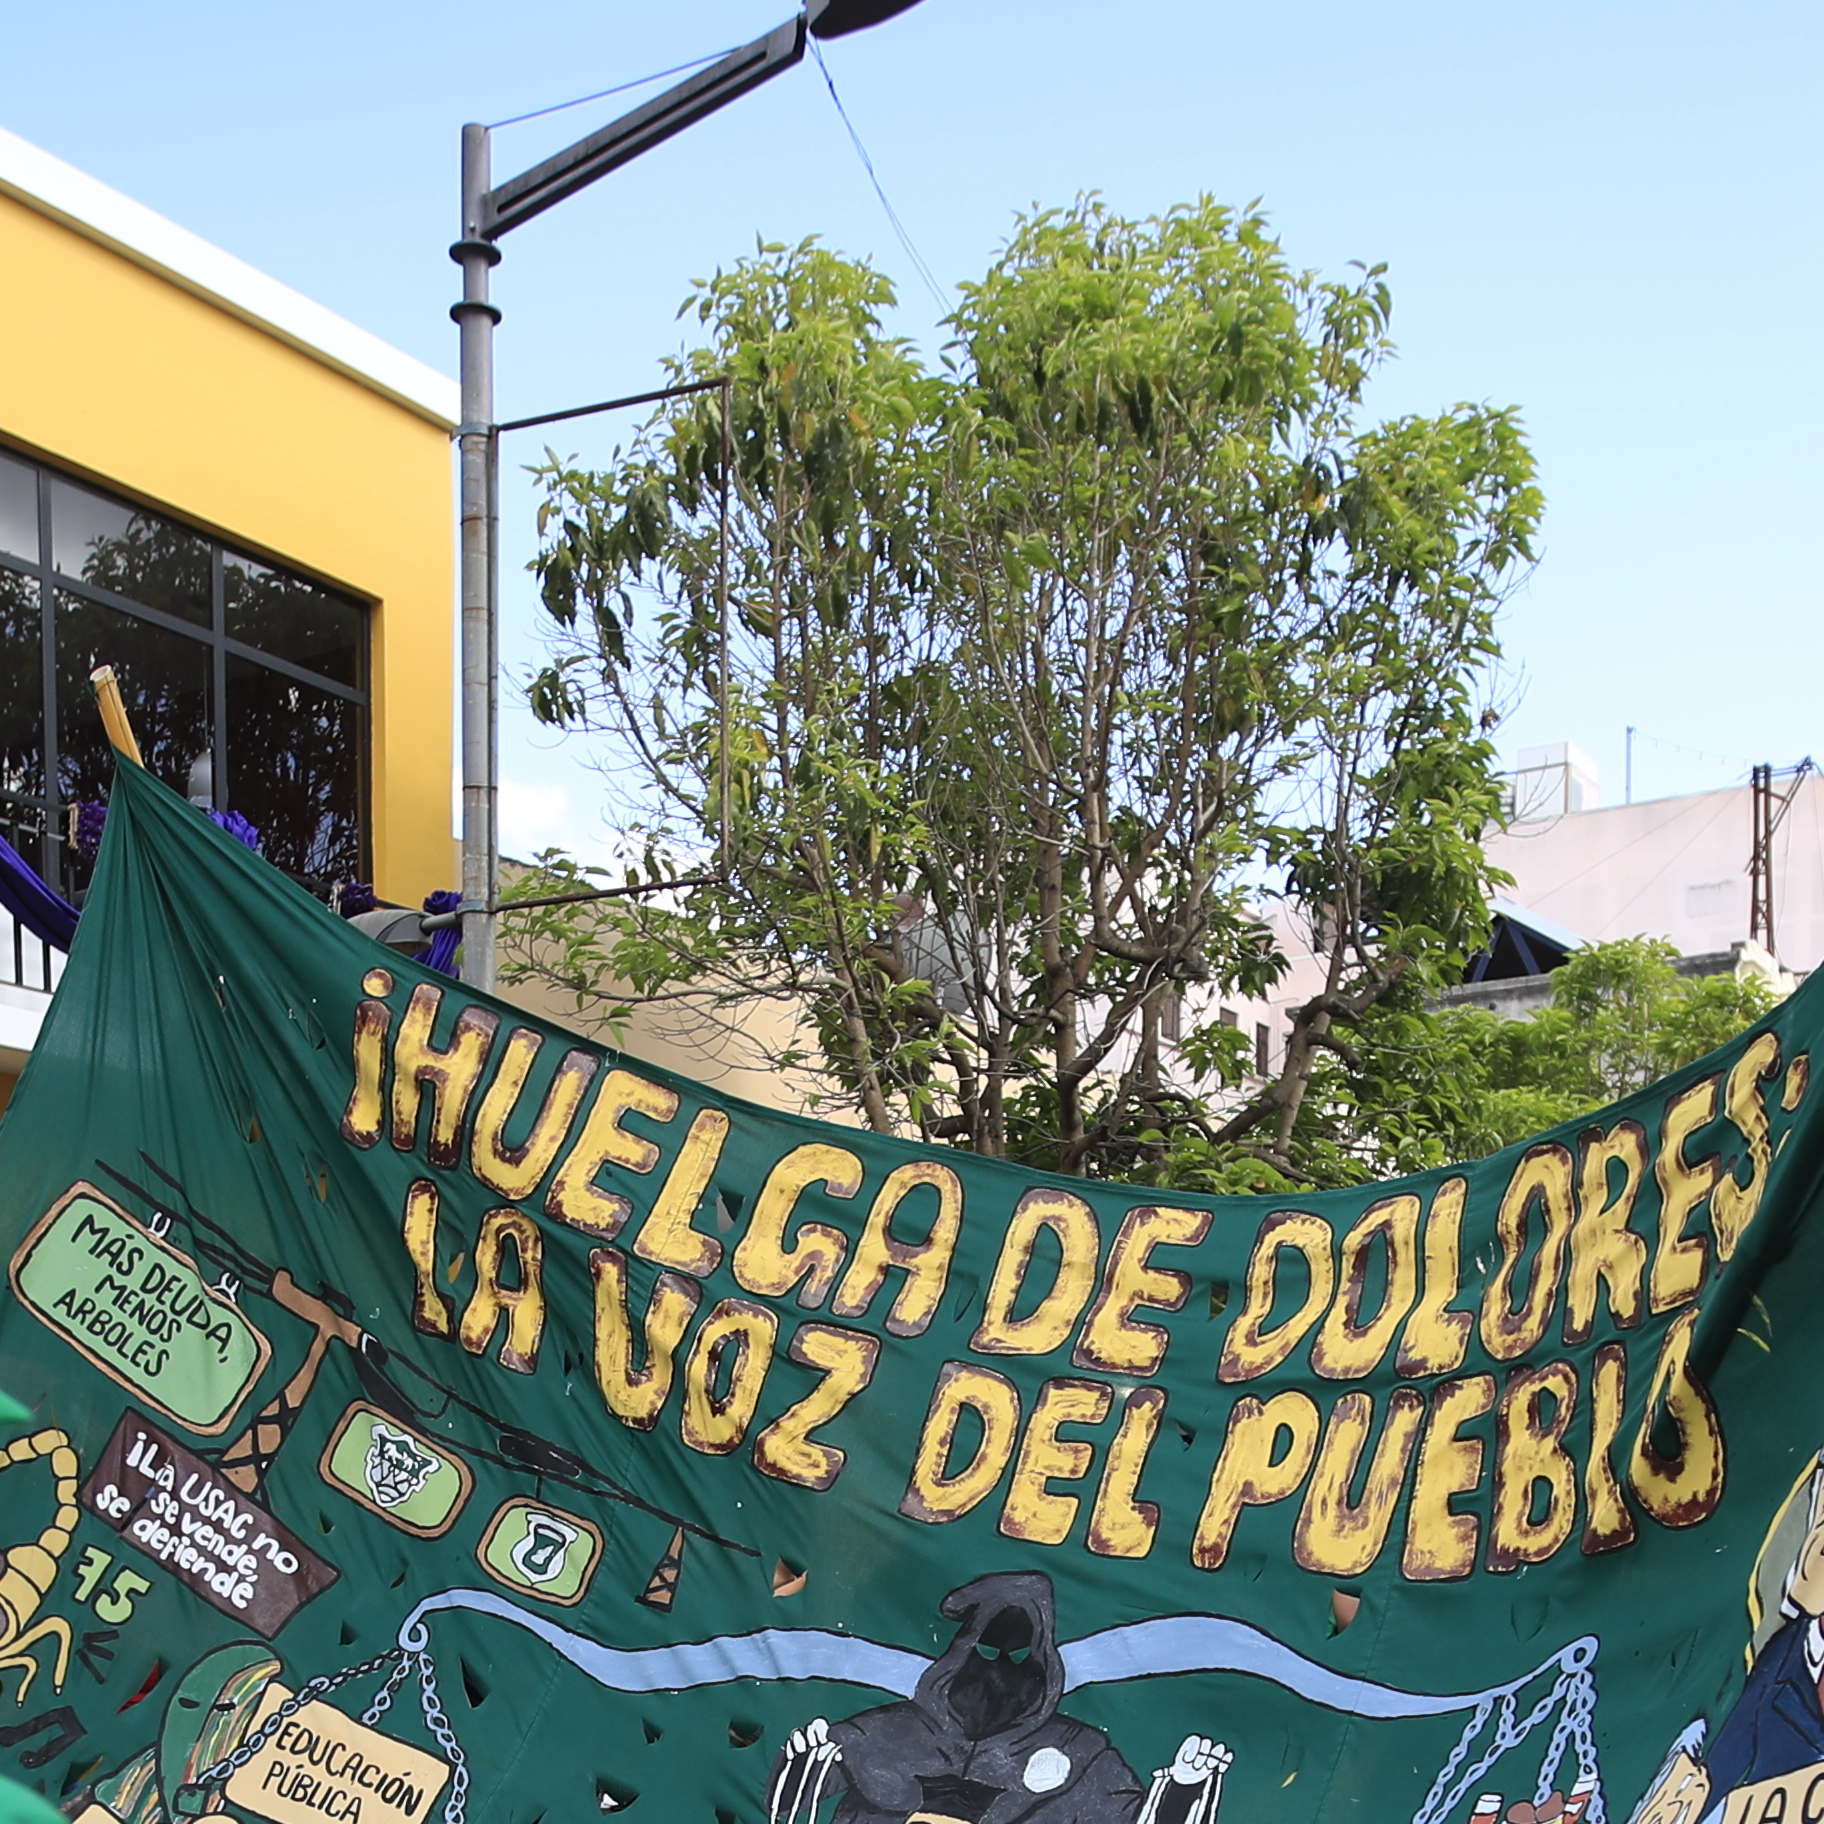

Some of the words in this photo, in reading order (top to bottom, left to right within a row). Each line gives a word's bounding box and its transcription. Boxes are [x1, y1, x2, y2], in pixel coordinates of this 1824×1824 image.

[339, 968, 965, 1338] ¡HUELGA
[968, 1187, 1213, 1377] DE
[52, 1287, 170, 1378] ARBOLES
[70, 1213, 145, 1277] MÁS
[139, 1262, 233, 1364] DEUDA,
[94, 1274, 182, 1344] MENOS
[401, 1179, 546, 1375] LA
[590, 1247, 881, 1491] VOZ
[900, 1361, 1168, 1558] DEL
[1190, 1306, 1726, 1582] PUEBLO
[96, 1484, 131, 1519] se
[150, 1491, 179, 1524] se
[180, 1473, 254, 1539] USAC
[252, 1533, 300, 1575] no
[74, 1545, 153, 1624] 75
[275, 1721, 425, 1817] EDUCACIÓN
